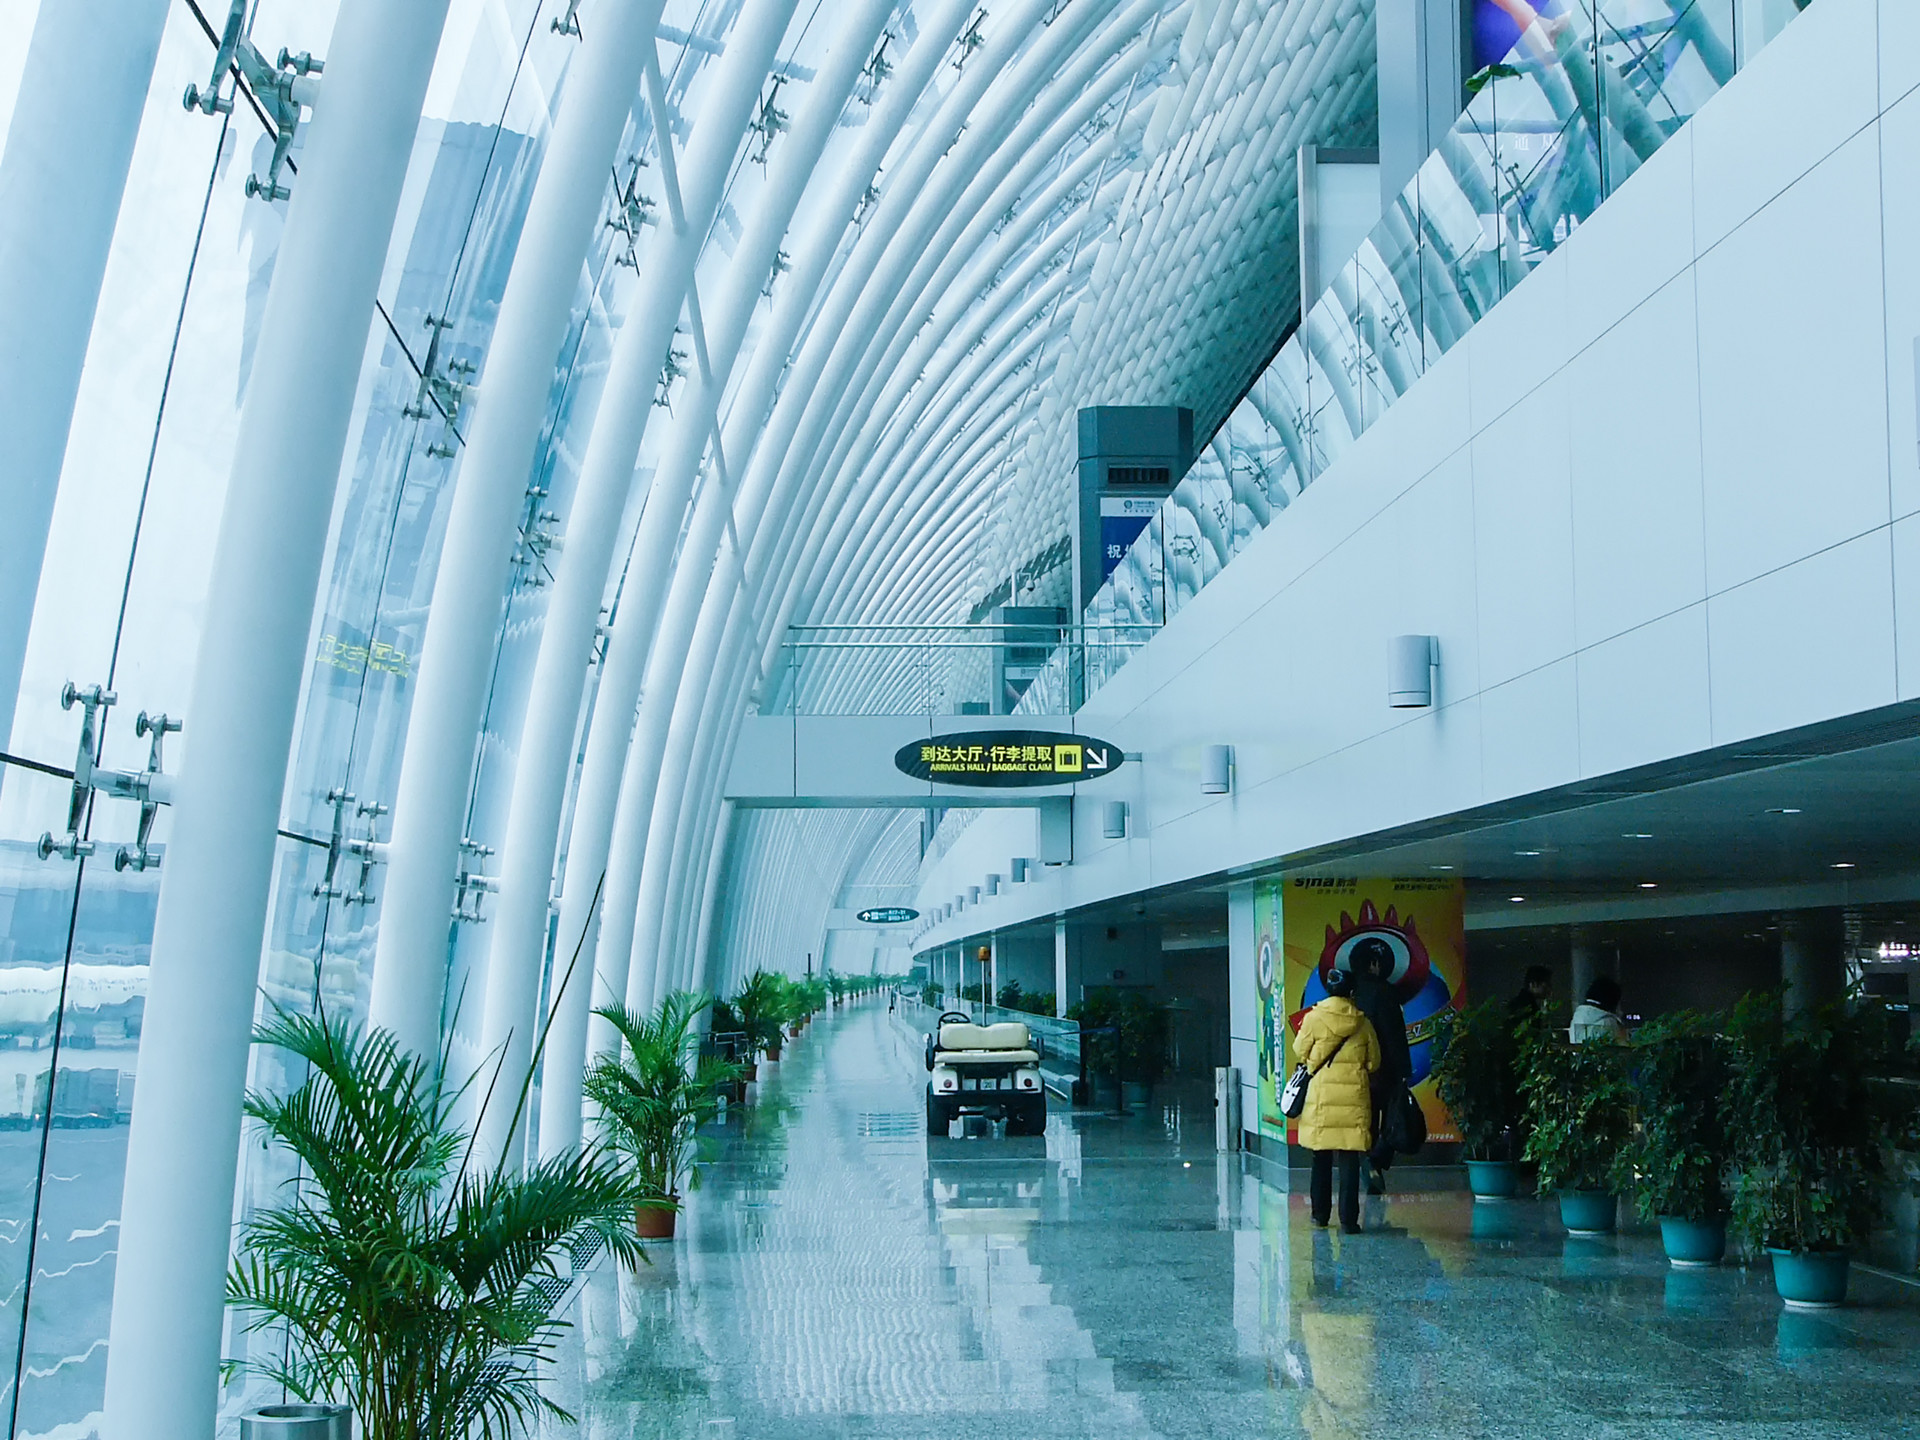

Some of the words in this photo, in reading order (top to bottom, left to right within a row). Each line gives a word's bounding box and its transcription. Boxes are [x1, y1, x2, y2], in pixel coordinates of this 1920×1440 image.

[921, 745, 1052, 762] 到达大厅·行李提取
[930, 763, 966, 772] ARRIVALS
[967, 763, 986, 772] HALL
[992, 763, 1027, 772] BAGGAGE
[1028, 763, 1052, 772] CLAIM
